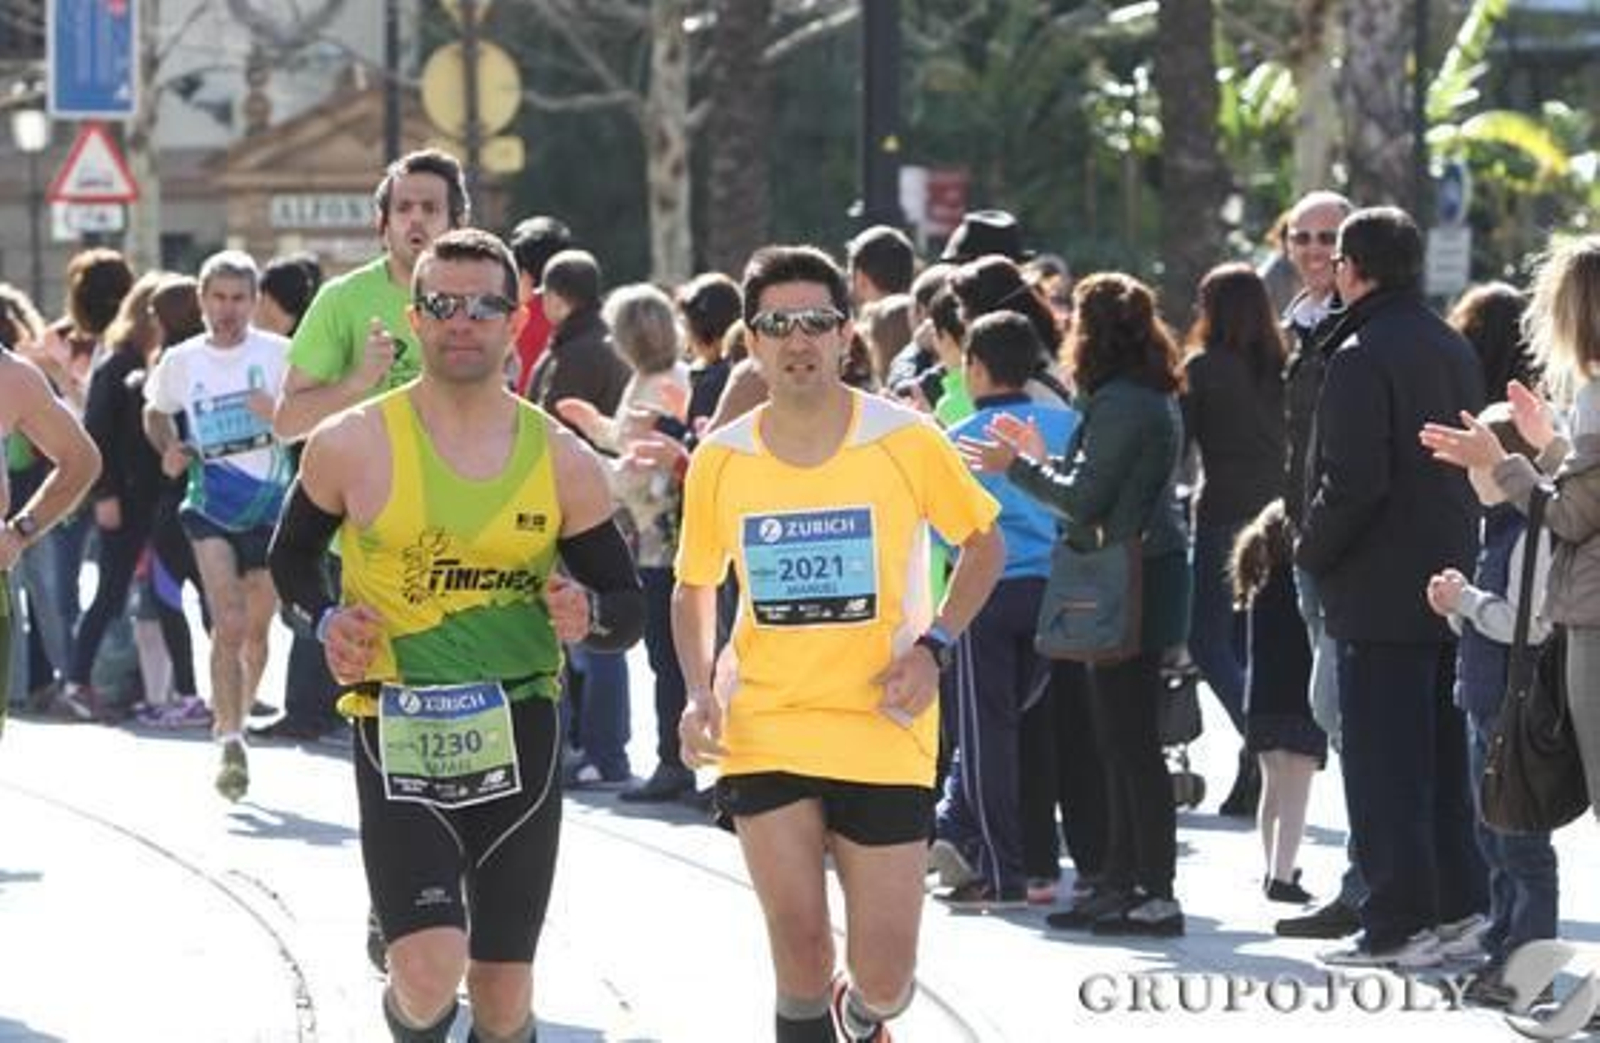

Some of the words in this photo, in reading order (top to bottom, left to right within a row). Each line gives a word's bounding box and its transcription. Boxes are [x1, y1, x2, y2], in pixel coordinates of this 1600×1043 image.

[785, 517, 855, 537] ZURICH
[778, 554, 844, 582] 2021
[424, 692, 486, 712] ZURICH
[419, 730, 482, 758] 1230
